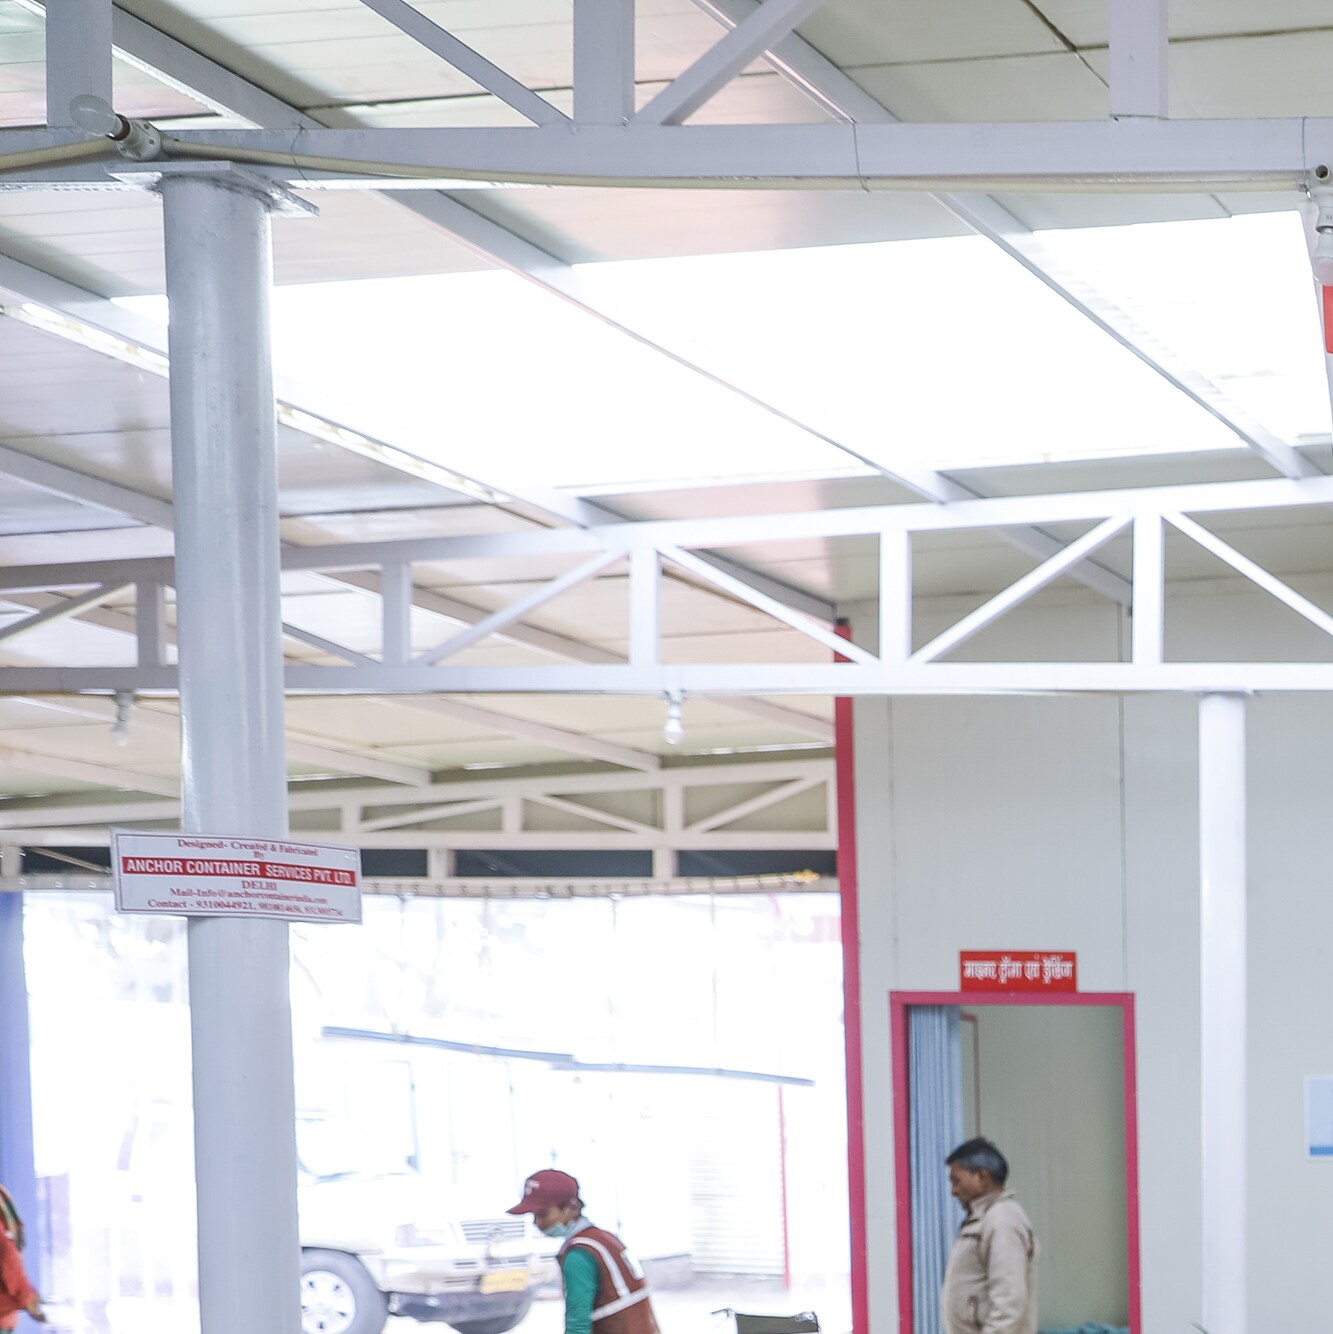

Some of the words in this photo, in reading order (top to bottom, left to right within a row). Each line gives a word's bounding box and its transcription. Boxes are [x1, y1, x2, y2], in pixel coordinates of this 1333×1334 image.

[230, 841, 268, 851] Created
[127, 859, 184, 873] ANCHOR
[186, 860, 260, 875] CONTAINER
[265, 864, 312, 880] SERVICES
[313, 869, 333, 883] PVT.
[241, 880, 277, 891] DELHI
[148, 899, 187, 909] Contact
